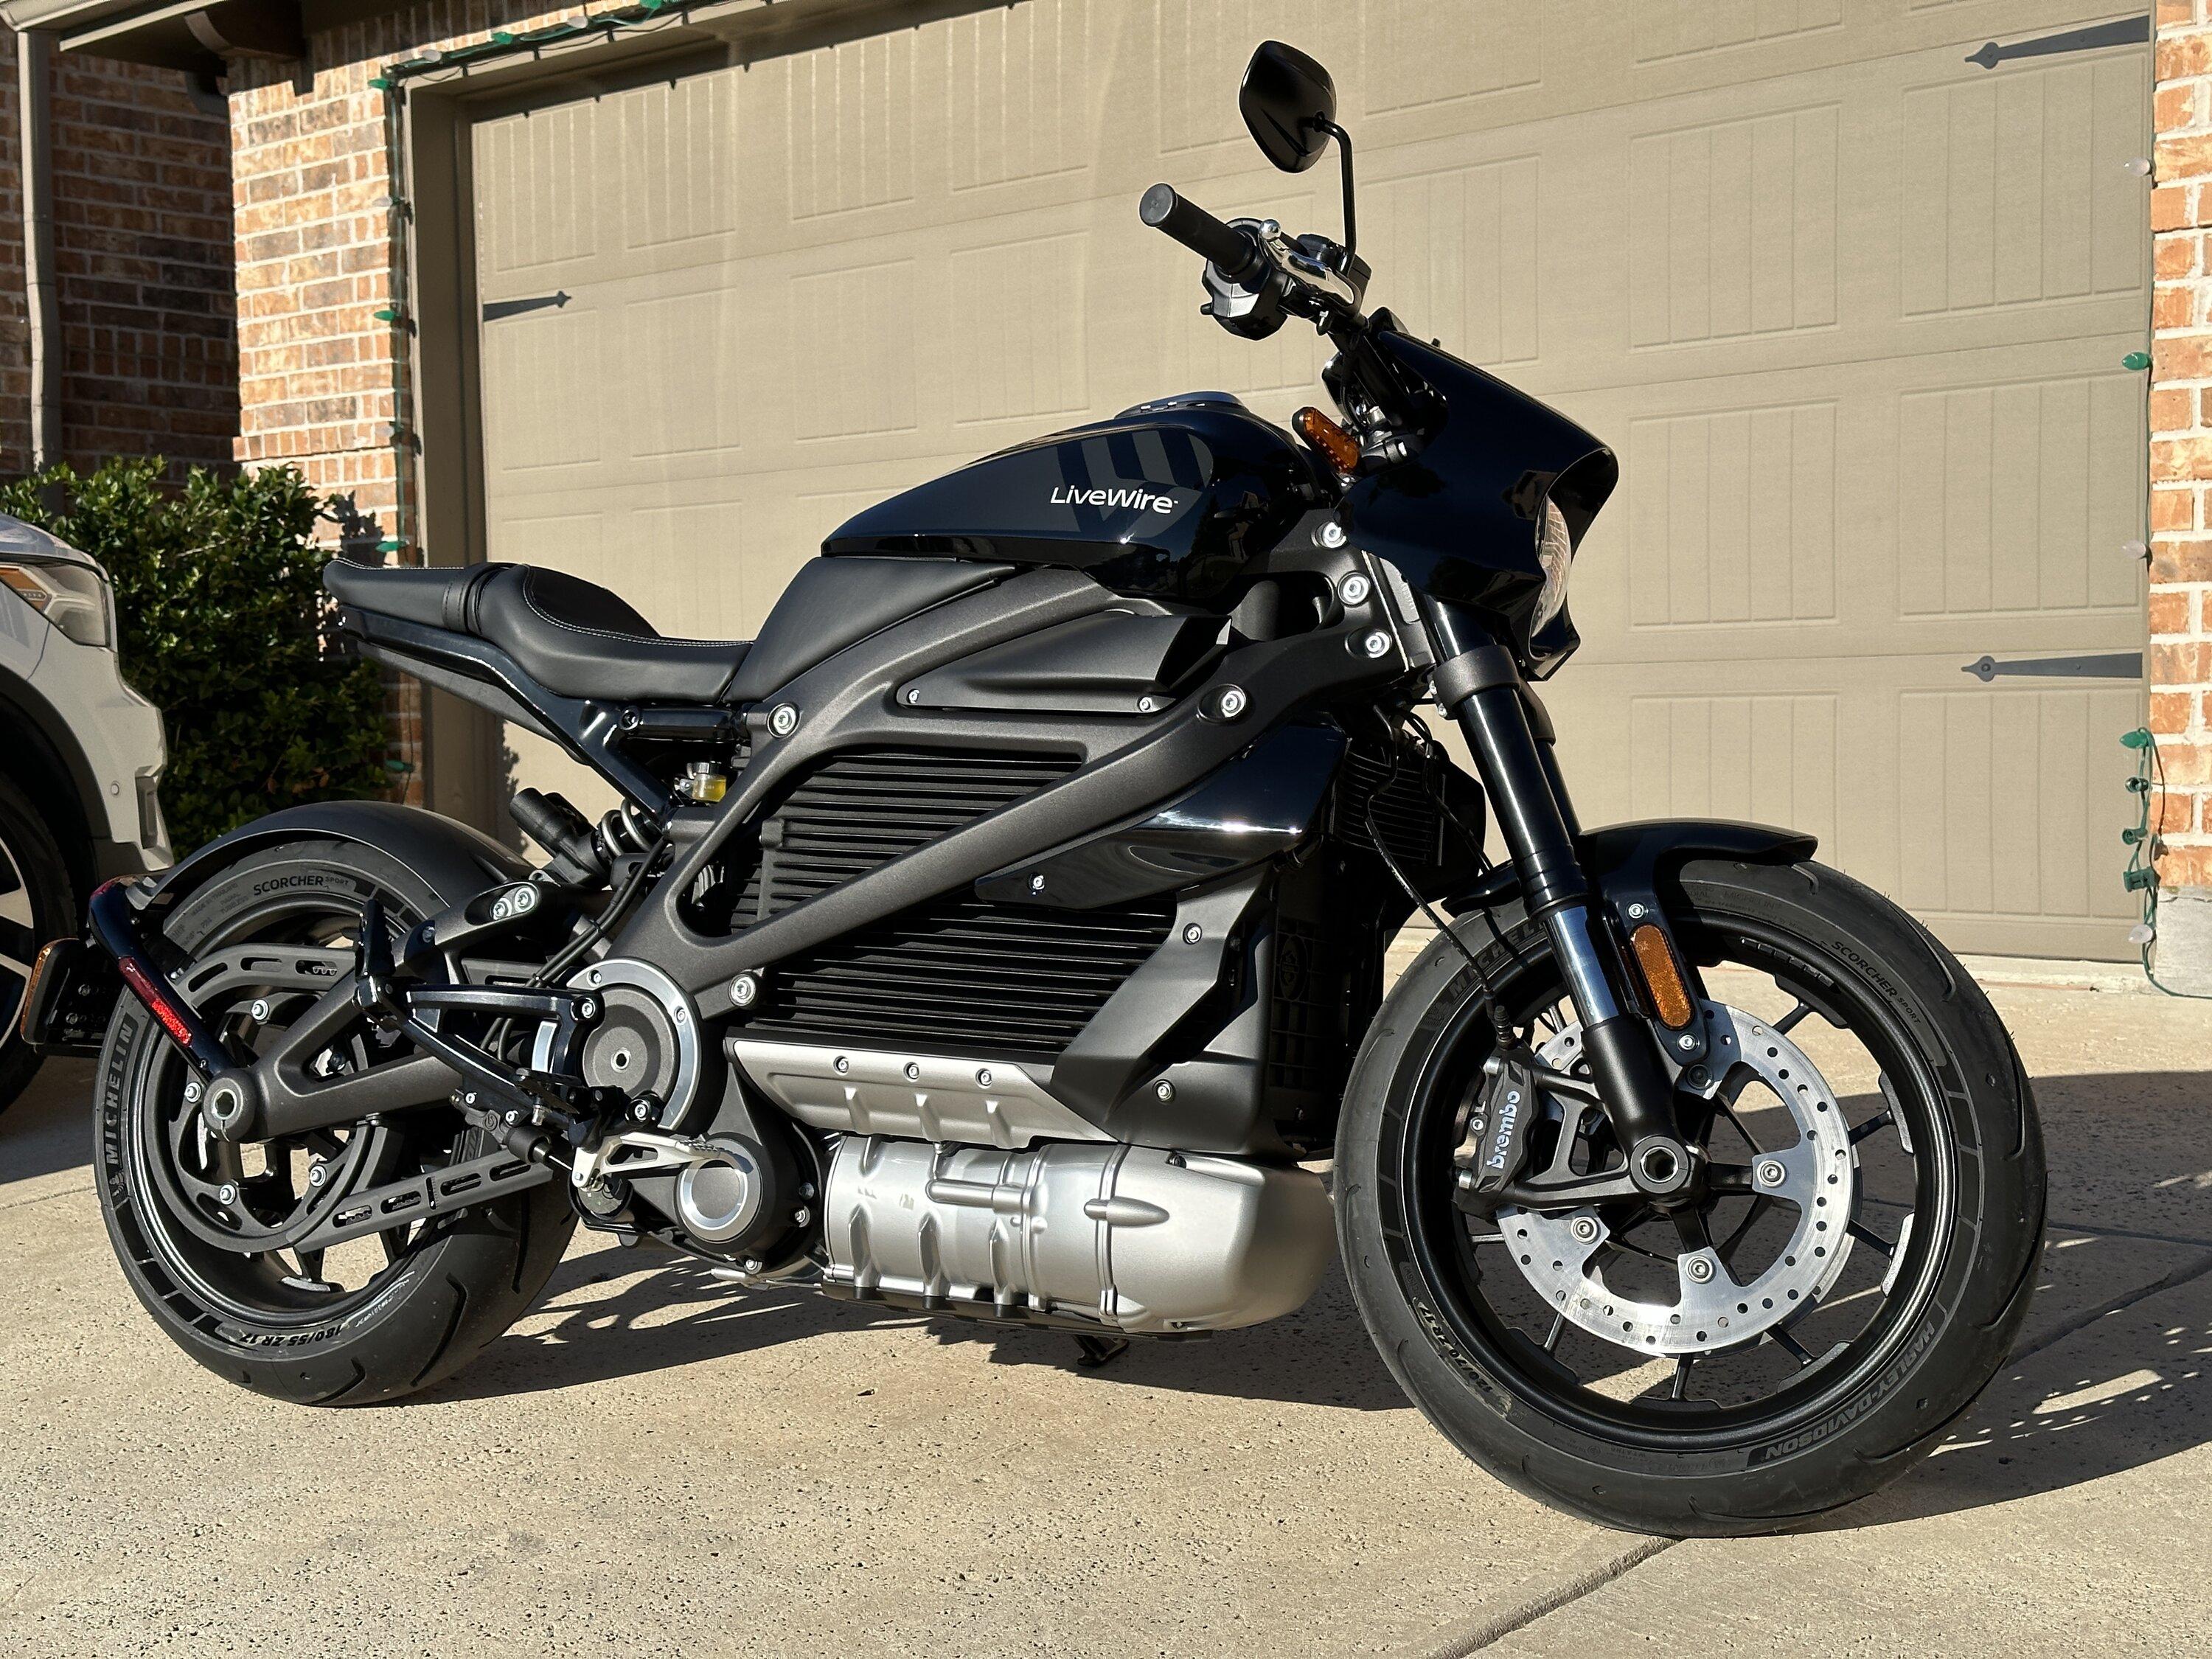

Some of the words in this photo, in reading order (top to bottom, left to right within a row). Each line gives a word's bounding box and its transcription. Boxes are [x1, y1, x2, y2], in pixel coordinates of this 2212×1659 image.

[1050, 485, 1174, 514] LiveWire
[254, 875, 323, 896] SCORCHER
[325, 876, 349, 886] SPORT
[1450, 920, 1545, 1000] MCHEL
[1831, 941, 1898, 997] SCORCHER
[1897, 997, 1921, 1023] SPORT
[106, 1023, 133, 1164] MICHELIN
[1486, 1091, 1520, 1169] brembo
[240, 1333, 258, 1345] 17
[261, 1335, 285, 1347] ZR
[288, 1324, 341, 1346] 180/55
[1449, 1349, 1493, 1393] 120/70
[1764, 1321, 1935, 1460] HARLEY-DAVIDSON
